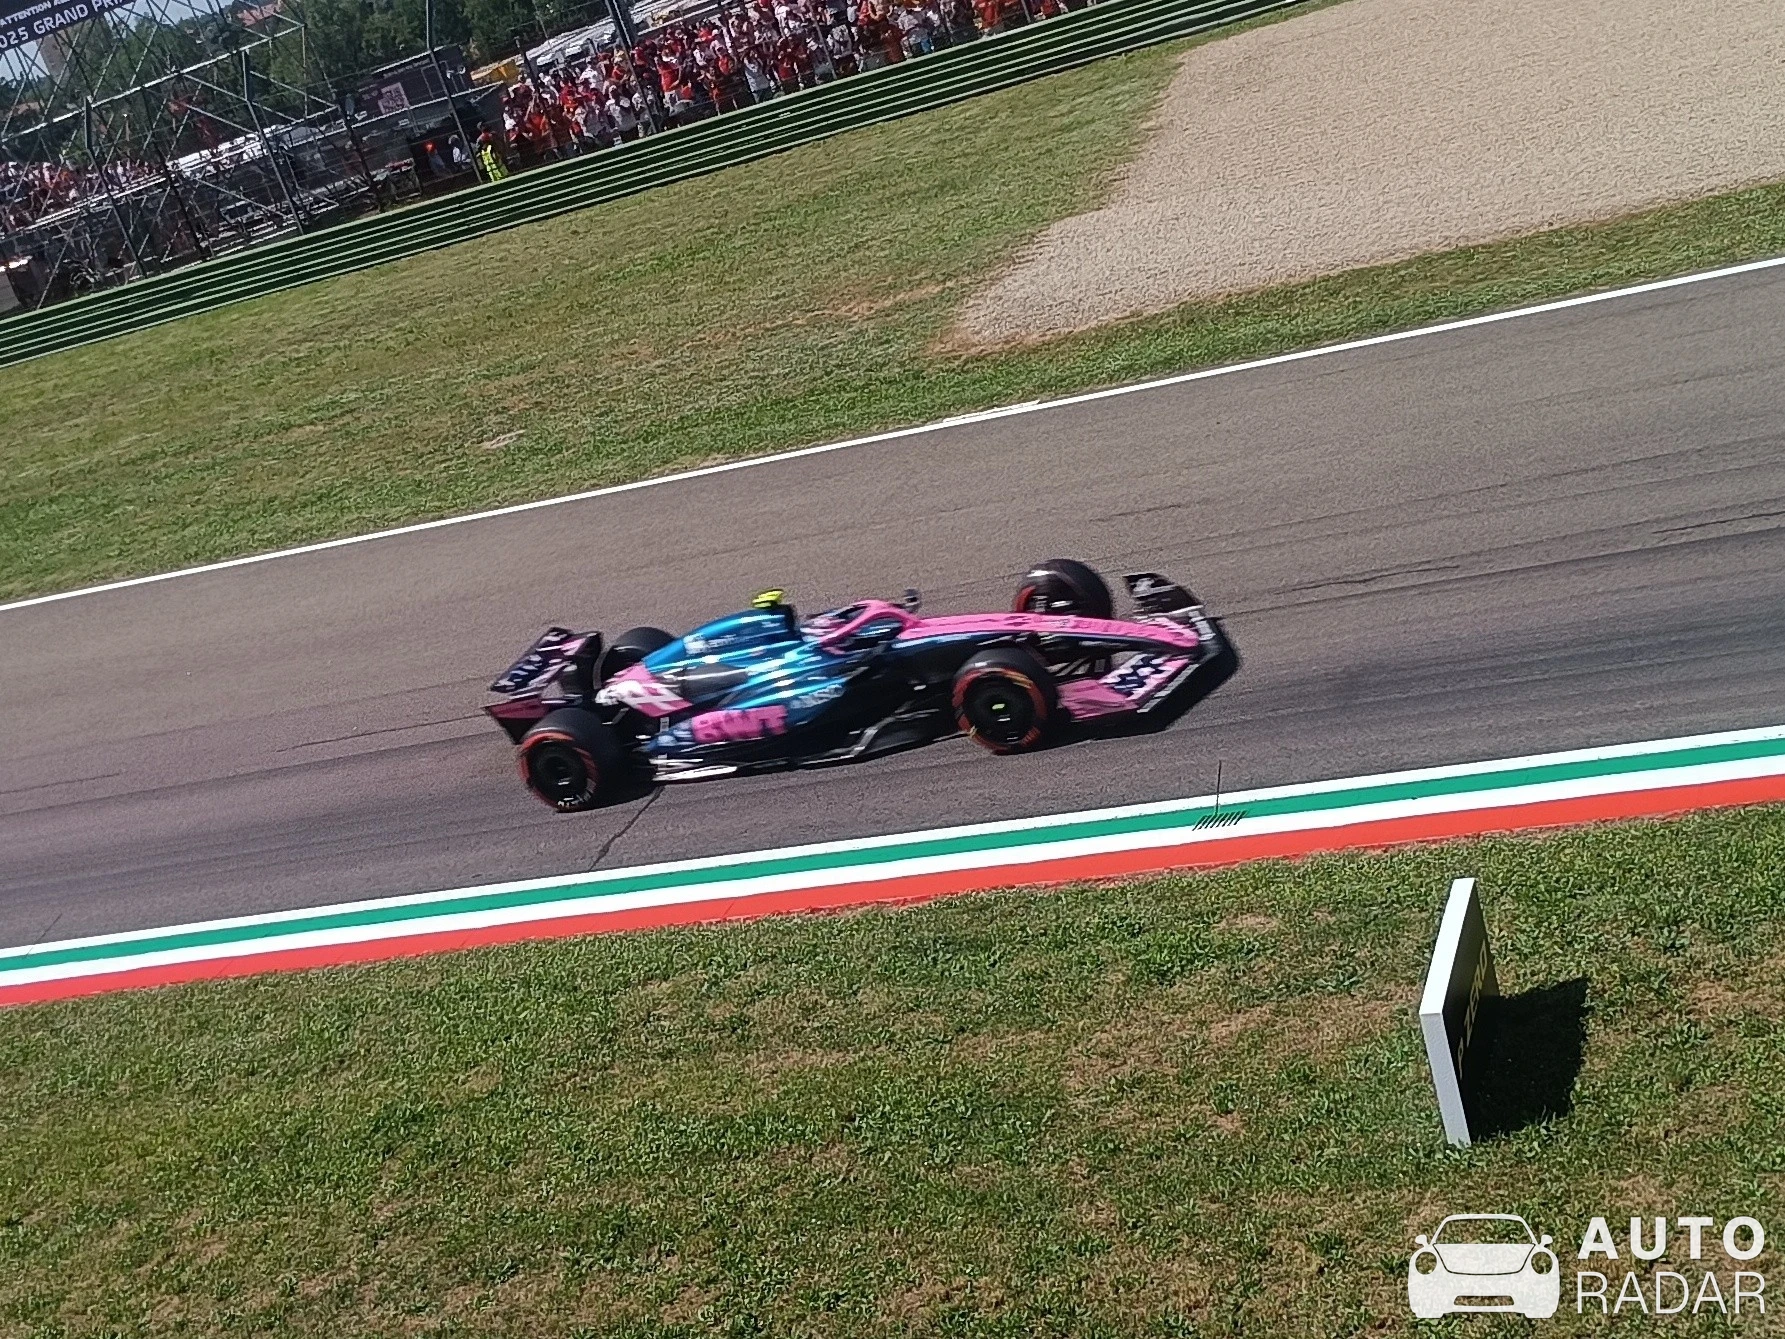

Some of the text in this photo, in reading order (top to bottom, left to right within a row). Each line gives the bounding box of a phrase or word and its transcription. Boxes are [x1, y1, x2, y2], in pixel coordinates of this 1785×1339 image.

[0, 1, 51, 26] ATTENTION
[34, 4, 88, 34] GRAND
[1457, 939, 1488, 1080] P ZERO
